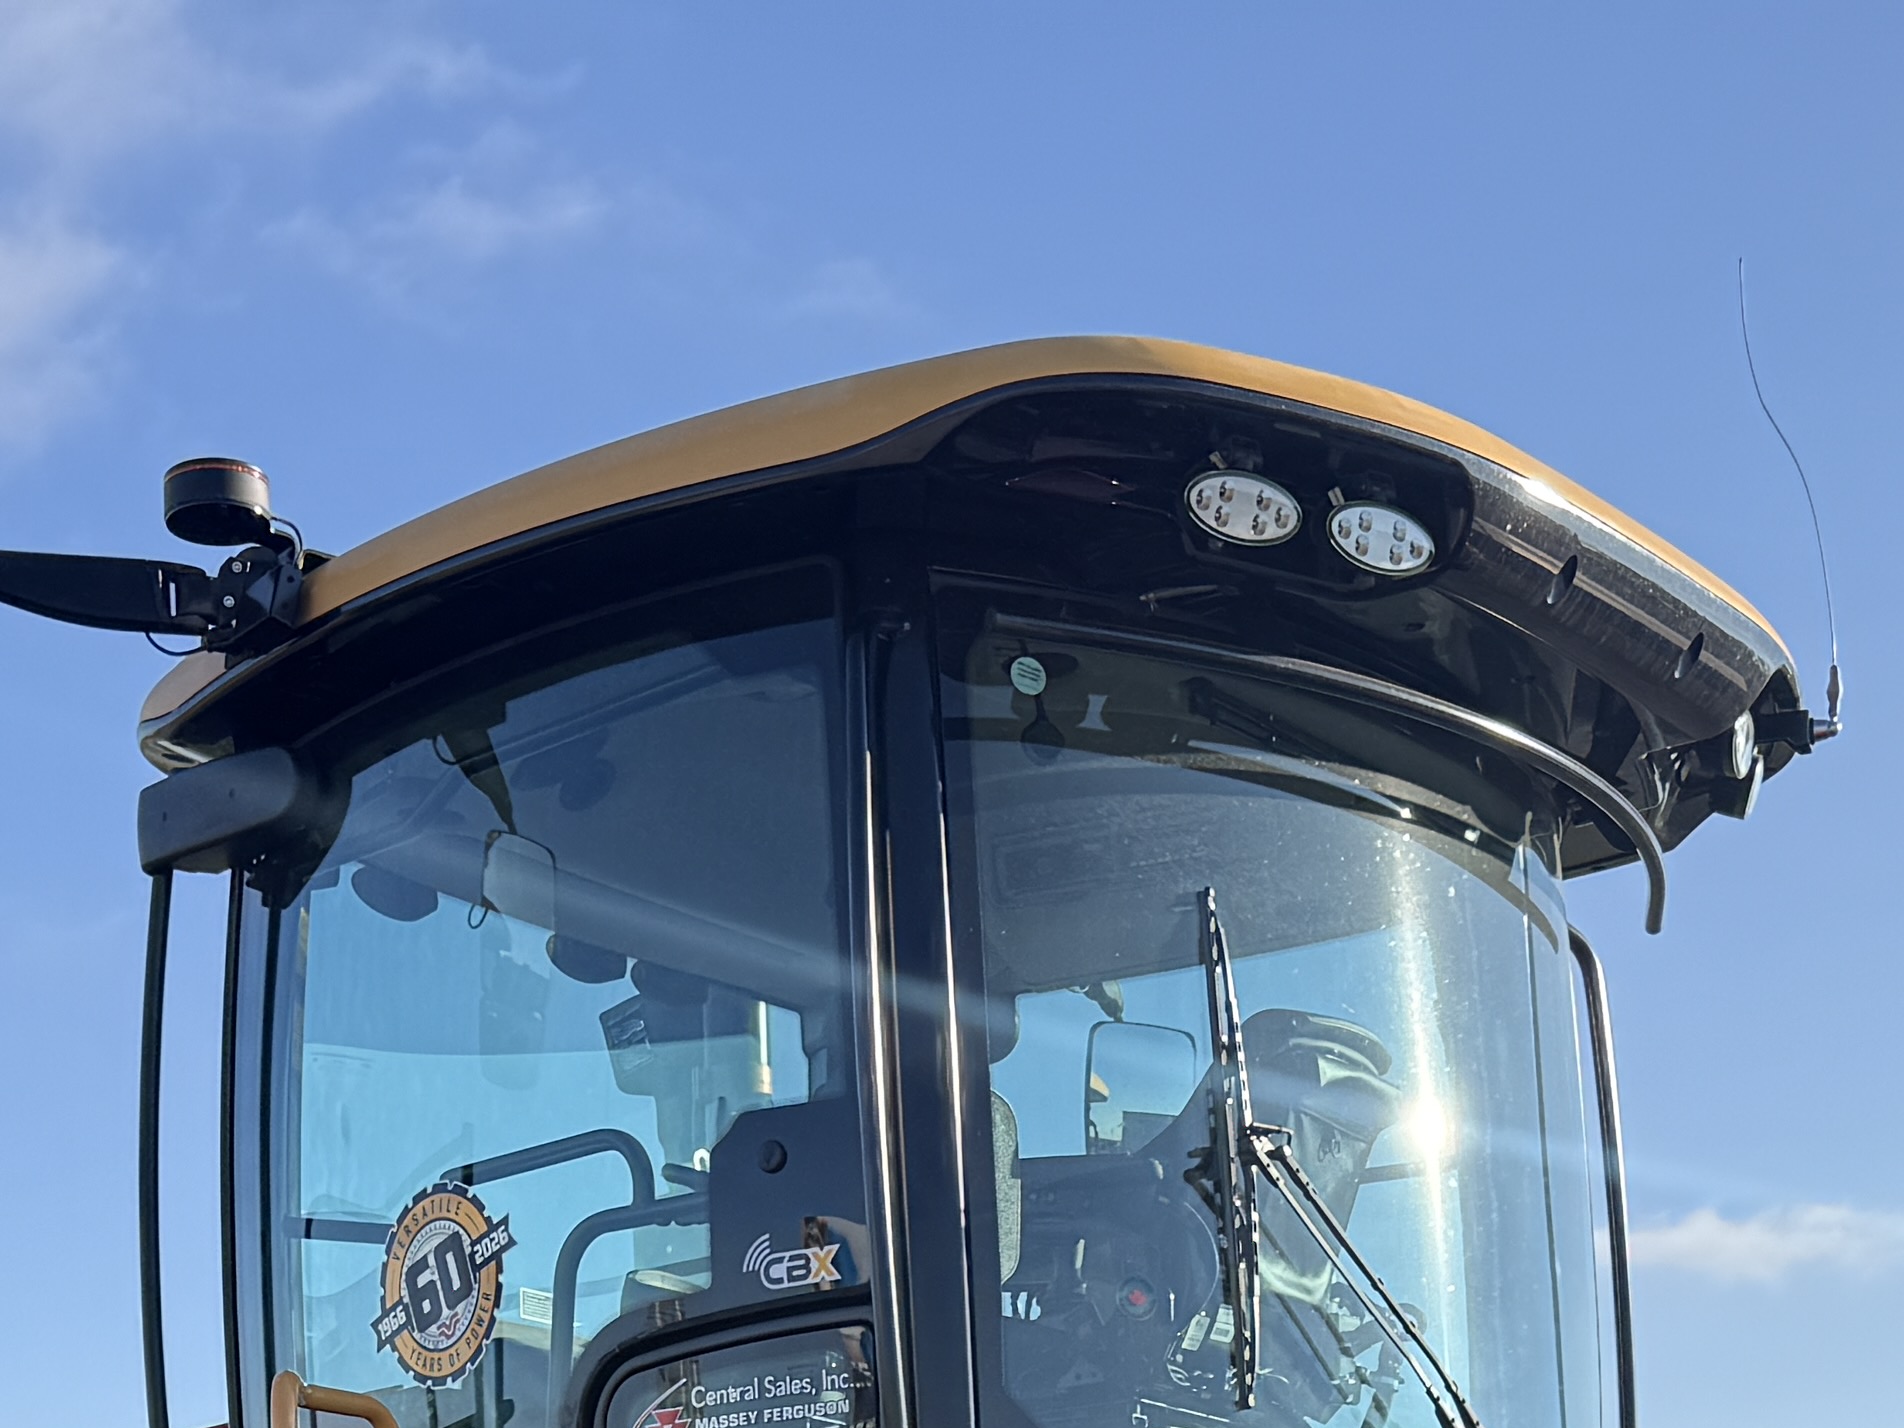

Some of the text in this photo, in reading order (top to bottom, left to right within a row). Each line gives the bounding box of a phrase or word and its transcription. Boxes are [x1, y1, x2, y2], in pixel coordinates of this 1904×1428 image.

[392, 1198, 462, 1262] VERSATILE
[474, 1224, 511, 1265] 2026
[405, 1230, 474, 1334] 60
[761, 1244, 842, 1290] CBX
[377, 1305, 408, 1341] 1966
[409, 1344, 443, 1373] YEARS
[449, 1349, 462, 1369] OF
[465, 1291, 493, 1350] POWER
[691, 1368, 855, 1409] Central Sales, Inc.
[763, 1400, 850, 1423] FERGUSON
